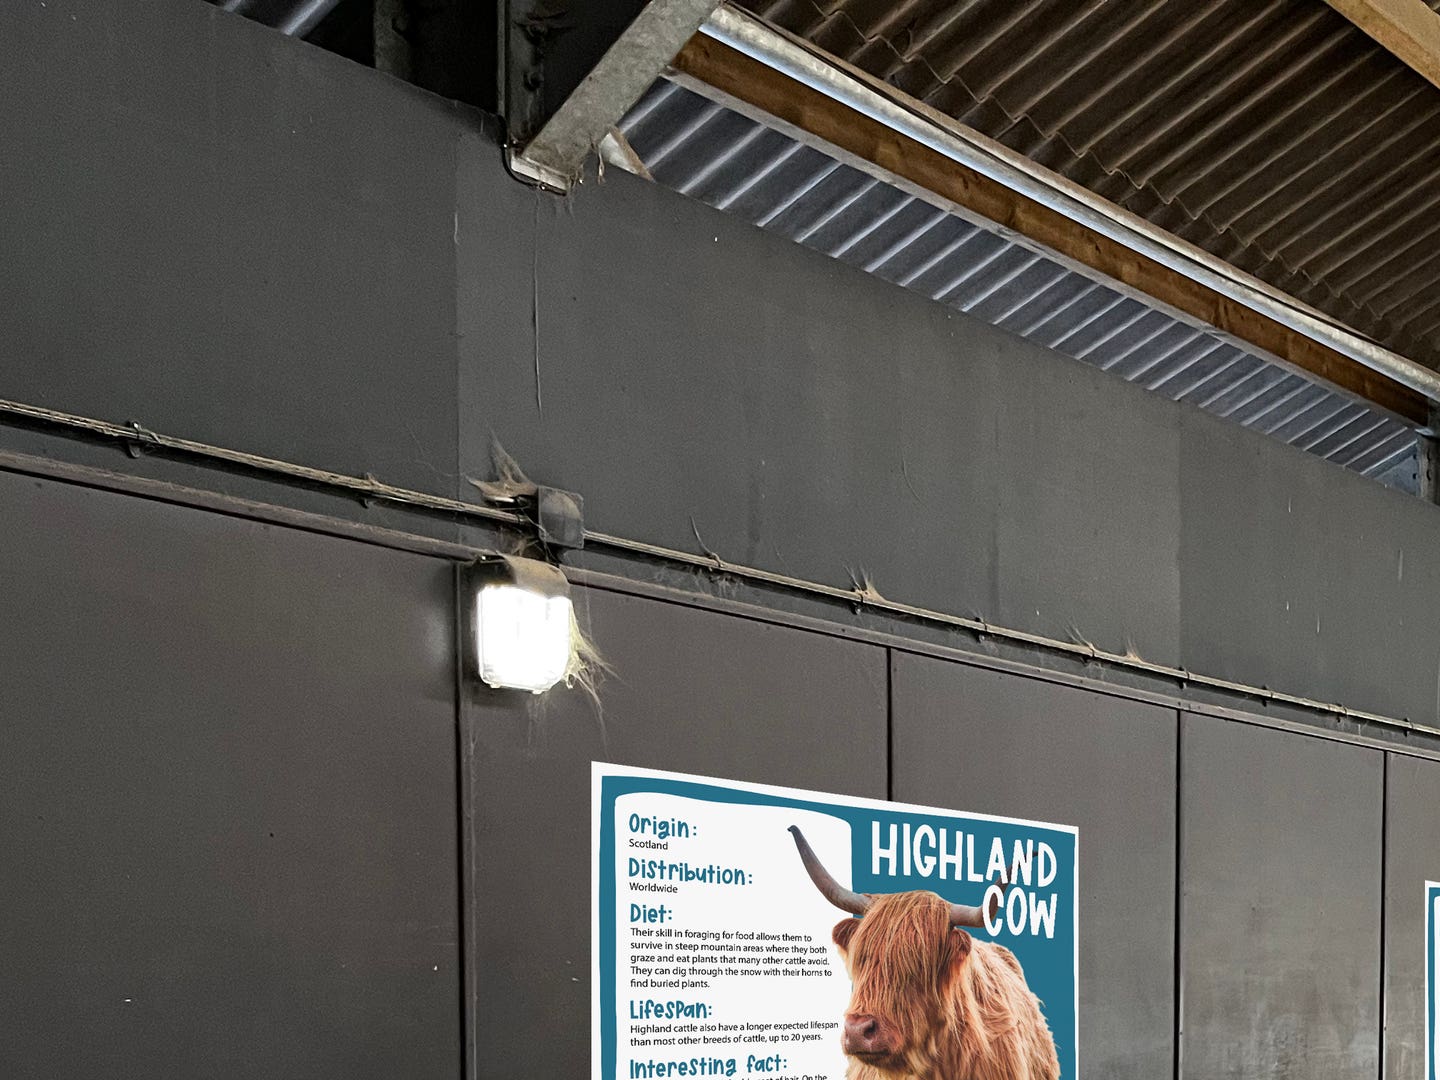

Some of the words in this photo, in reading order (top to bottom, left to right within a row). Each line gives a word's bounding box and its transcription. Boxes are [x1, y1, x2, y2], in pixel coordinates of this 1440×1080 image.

[629, 813, 697, 839] Origin:
[629, 838, 668, 850] Scotland
[872, 821, 1057, 887] HIGHLAND
[629, 857, 752, 886] Distribution:
[629, 882, 678, 894] Worldwide
[630, 903, 672, 924] Diet:
[982, 885, 1057, 939] COW
[630, 927, 654, 937] Their
[655, 928, 672, 937] skill
[674, 929, 683, 938] in
[684, 929, 720, 940] foraging
[722, 930, 734, 939] for
[735, 931, 754, 940] food
[756, 932, 781, 941] allows
[782, 933, 802, 942] them
[630, 941, 663, 950] survive
[665, 942, 673, 950] in
[675, 942, 699, 952] steep
[701, 943, 742, 952] mountain
[765, 944, 790, 953] where
[791, 945, 808, 955] they
[810, 945, 827, 954] both
[630, 955, 655, 963] graze
[657, 954, 674, 963] and
[676, 955, 690, 963] eat
[692, 955, 718, 965] plants
[720, 955, 736, 964] that
[738, 957, 761, 966] many
[762, 956, 784, 965] other
[784, 957, 806, 965] cattle
[630, 966, 653, 977] They
[672, 966, 687, 977] dig
[688, 966, 723, 978] through
[725, 967, 739, 976] the
[763, 968, 781, 976] with
[782, 968, 800, 976] their
[801, 968, 823, 977] horns
[824, 969, 832, 977] to
[630, 978, 648, 988] find
[650, 979, 680, 988] buried
[681, 980, 710, 989] plants.
[630, 999, 712, 1020] Lifespan:
[630, 1024, 672, 1035] Highland
[673, 1023, 698, 1033] cattle
[699, 1024, 717, 1032] also
[718, 1023, 739, 1031] have
[746, 1022, 772, 1032] longer
[773, 1021, 809, 1031] expected
[810, 1021, 839, 1030] lifespan
[630, 1037, 651, 1047] than
[653, 1038, 675, 1046] most
[677, 1036, 701, 1045] other
[703, 1035, 731, 1044] breeds
[733, 1034, 742, 1043] of
[743, 1034, 767, 1043] cattle,
[768, 1035, 780, 1043] up
[781, 1034, 789, 1042] to
[791, 1033, 801, 1041] 20
[801, 1034, 822, 1042] years.
[630, 1057, 737, 1079] Interesting
[746, 1054, 787, 1073] fact:
